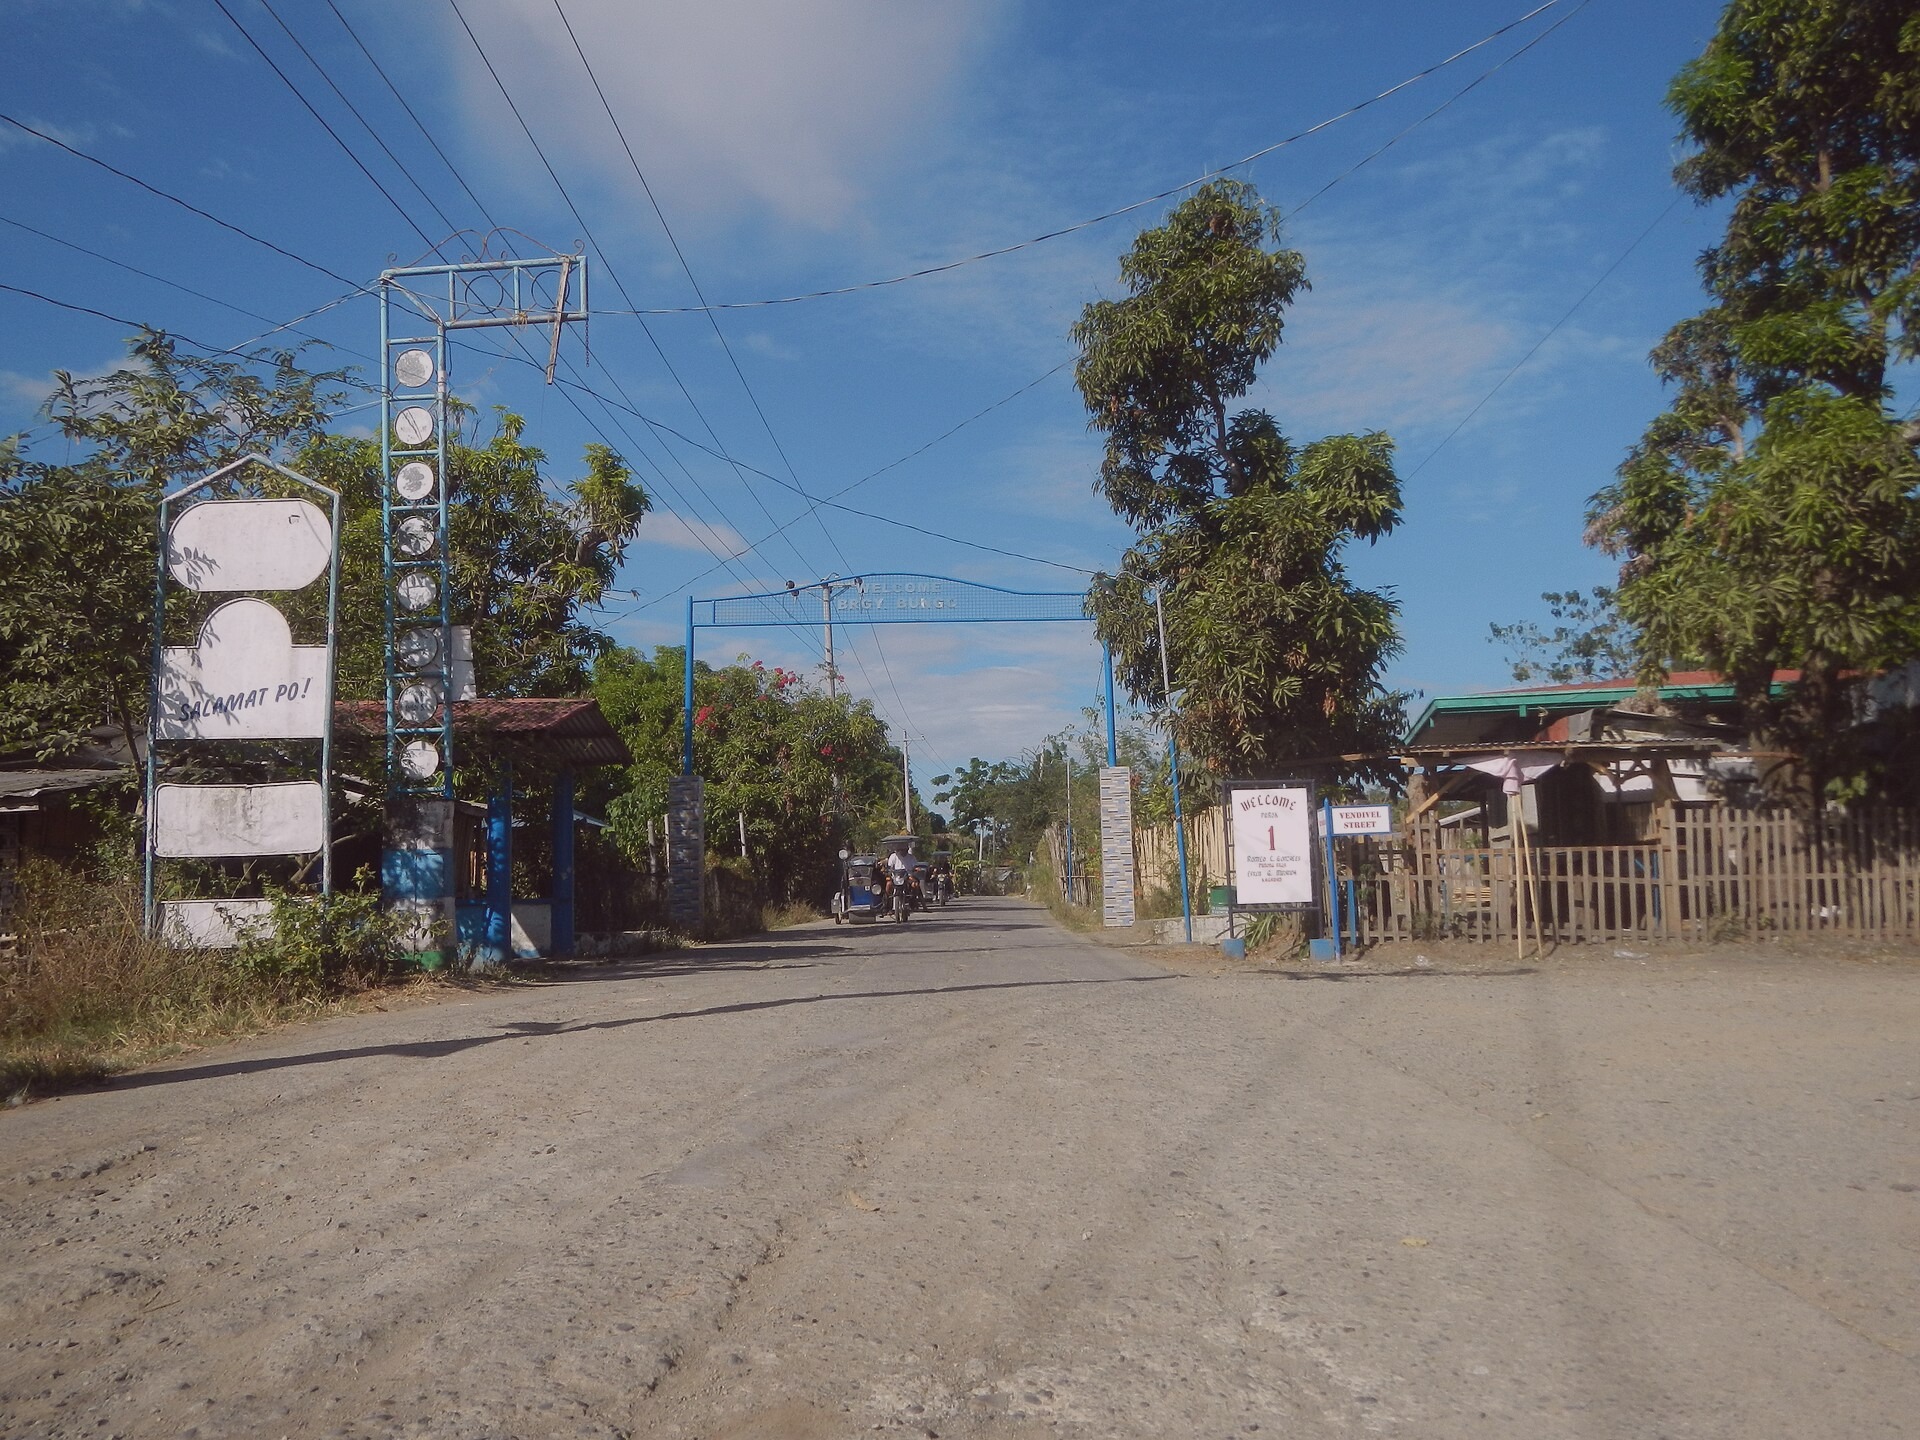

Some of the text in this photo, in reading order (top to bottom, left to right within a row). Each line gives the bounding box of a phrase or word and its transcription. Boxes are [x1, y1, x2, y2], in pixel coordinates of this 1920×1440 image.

[857, 582, 942, 594] WELCOME
[179, 677, 312, 722] SALAMAT PO!
[1240, 794, 1296, 811] WELCOME
[1339, 811, 1382, 820] VENDIVEL
[1343, 821, 1377, 829] STREET
[1267, 825, 1276, 851] 1
